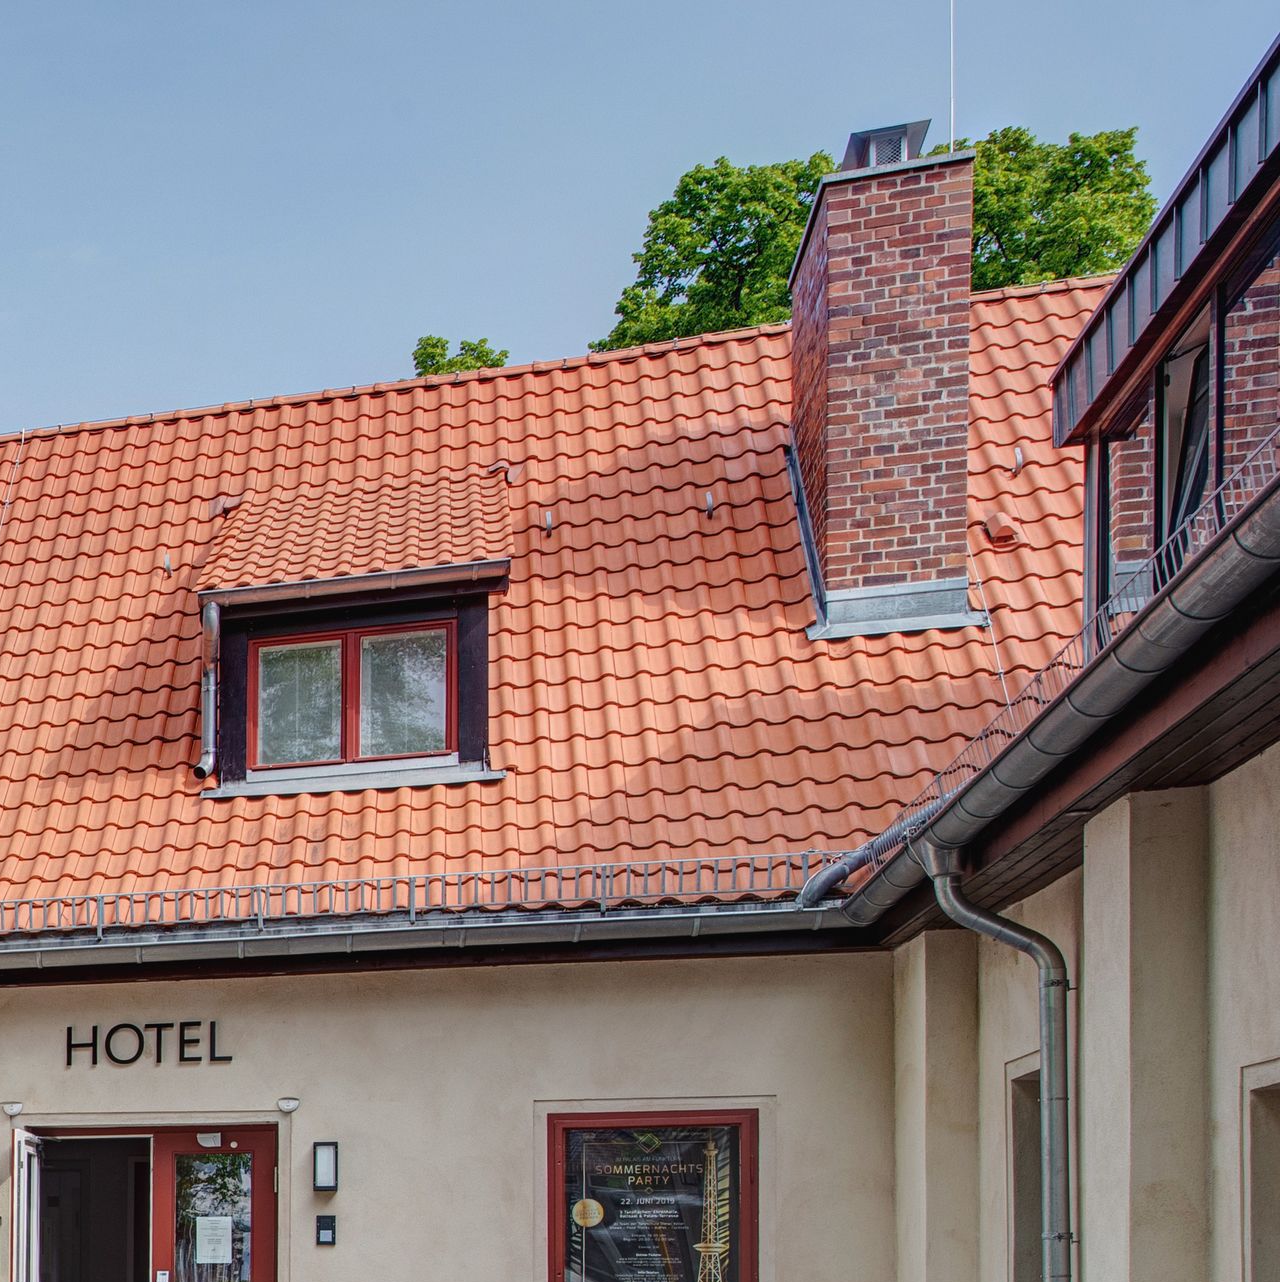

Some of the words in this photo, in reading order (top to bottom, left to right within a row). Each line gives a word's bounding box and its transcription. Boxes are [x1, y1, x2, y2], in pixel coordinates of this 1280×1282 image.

[66, 1020, 233, 1067] HOTEL
[595, 1163, 704, 1175] SOMMERNACHTS
[628, 1175, 670, 1185] PARTY
[636, 1197, 653, 1205] JUNI
[655, 1197, 675, 1205] 2019
